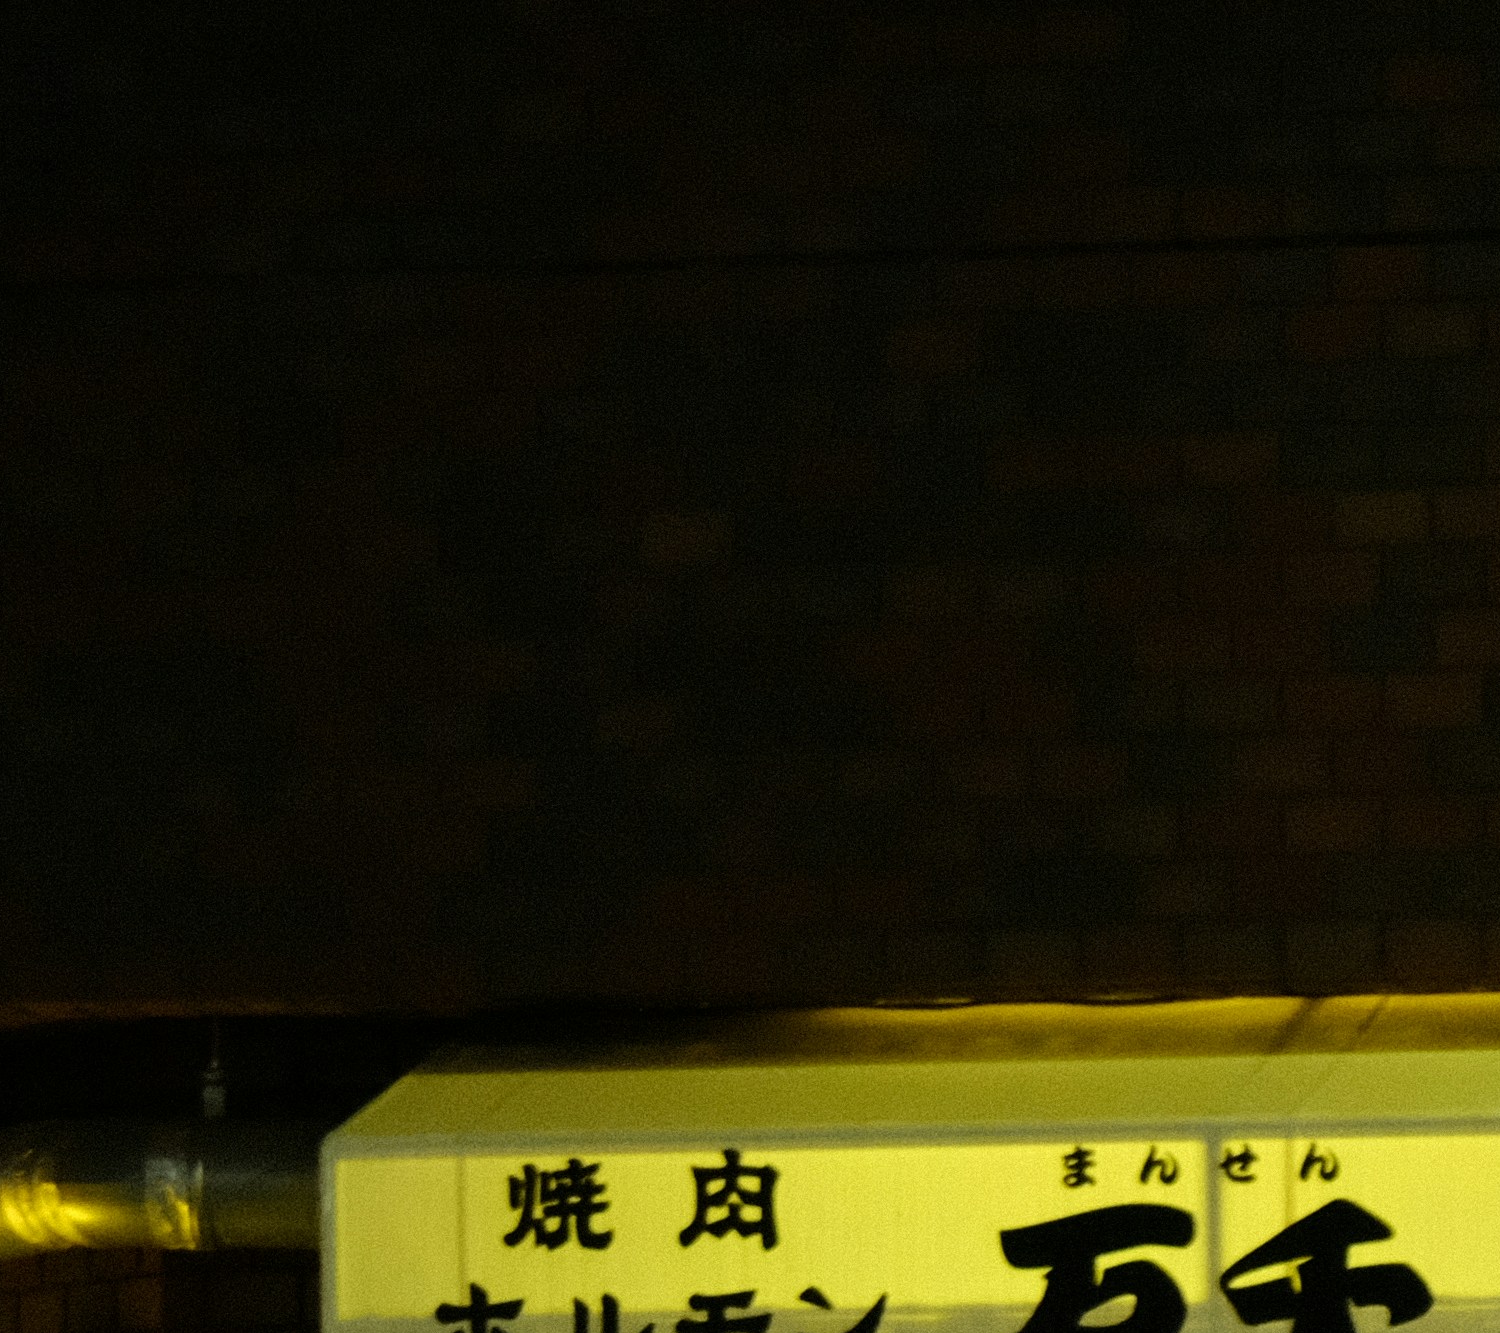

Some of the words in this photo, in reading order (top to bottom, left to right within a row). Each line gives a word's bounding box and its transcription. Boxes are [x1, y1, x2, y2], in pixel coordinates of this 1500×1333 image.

[503, 1149, 783, 1250] 焼肉
[1059, 1142, 1342, 1187] まんせん
